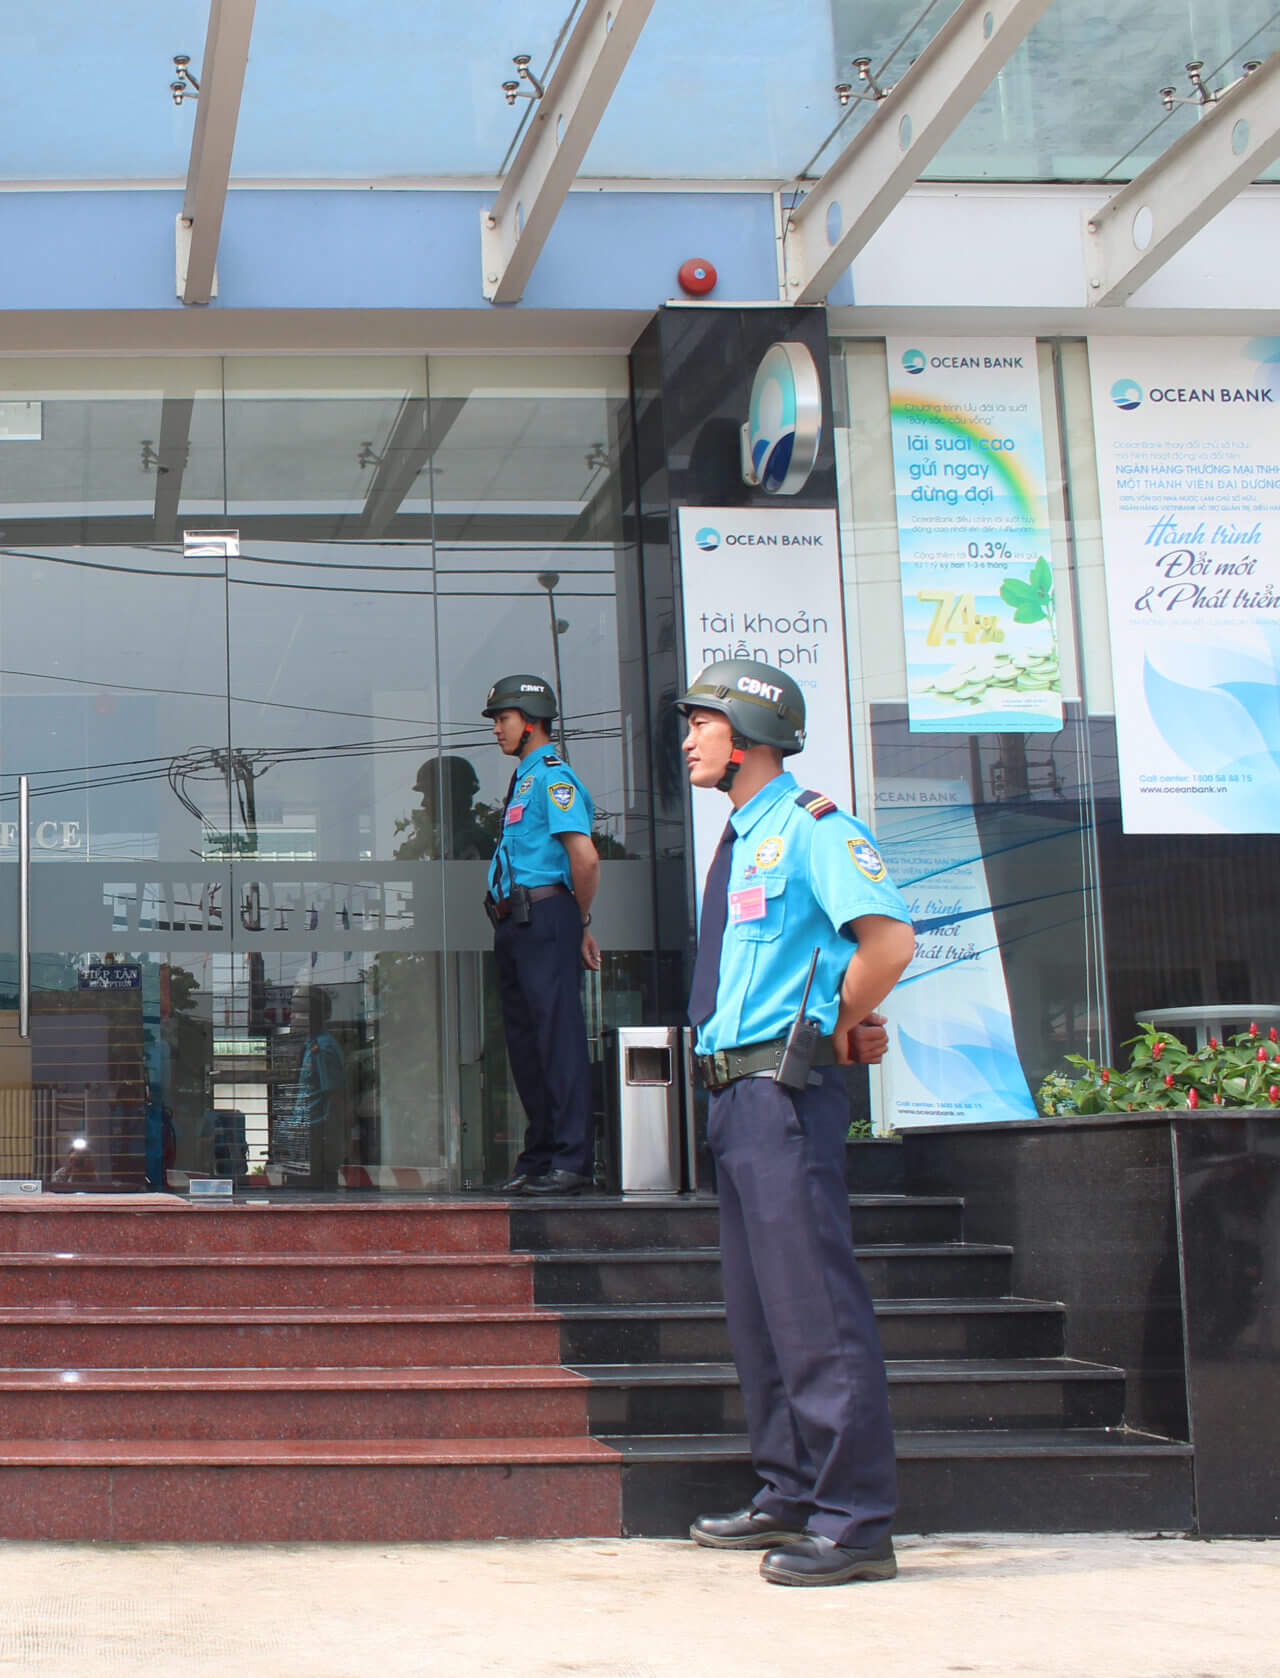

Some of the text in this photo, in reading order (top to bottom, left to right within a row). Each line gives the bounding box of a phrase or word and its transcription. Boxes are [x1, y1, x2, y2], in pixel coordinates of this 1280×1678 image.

[930, 357, 1024, 368] OCEAN BANK
[1149, 388, 1273, 402] OCEAN BANK
[907, 434, 929, 451] lãi
[979, 438, 1016, 451] cao
[909, 457, 990, 480] gửi ngay
[911, 485, 994, 506] đừng đợi
[725, 534, 824, 546] OCEAN BANK
[1144, 513, 1264, 547] Hành trình
[968, 542, 1013, 559] 0.3%
[1155, 549, 1258, 578] Đổi mới
[1134, 582, 1280, 613] & Phát triển
[699, 610, 828, 633] tài khoản
[702, 640, 819, 669] miễn phí
[919, 791, 959, 802] BANK
[1140, 785, 1228, 794] www.oceanbank.vn
[102, 881, 415, 931] TANI OFFICE
